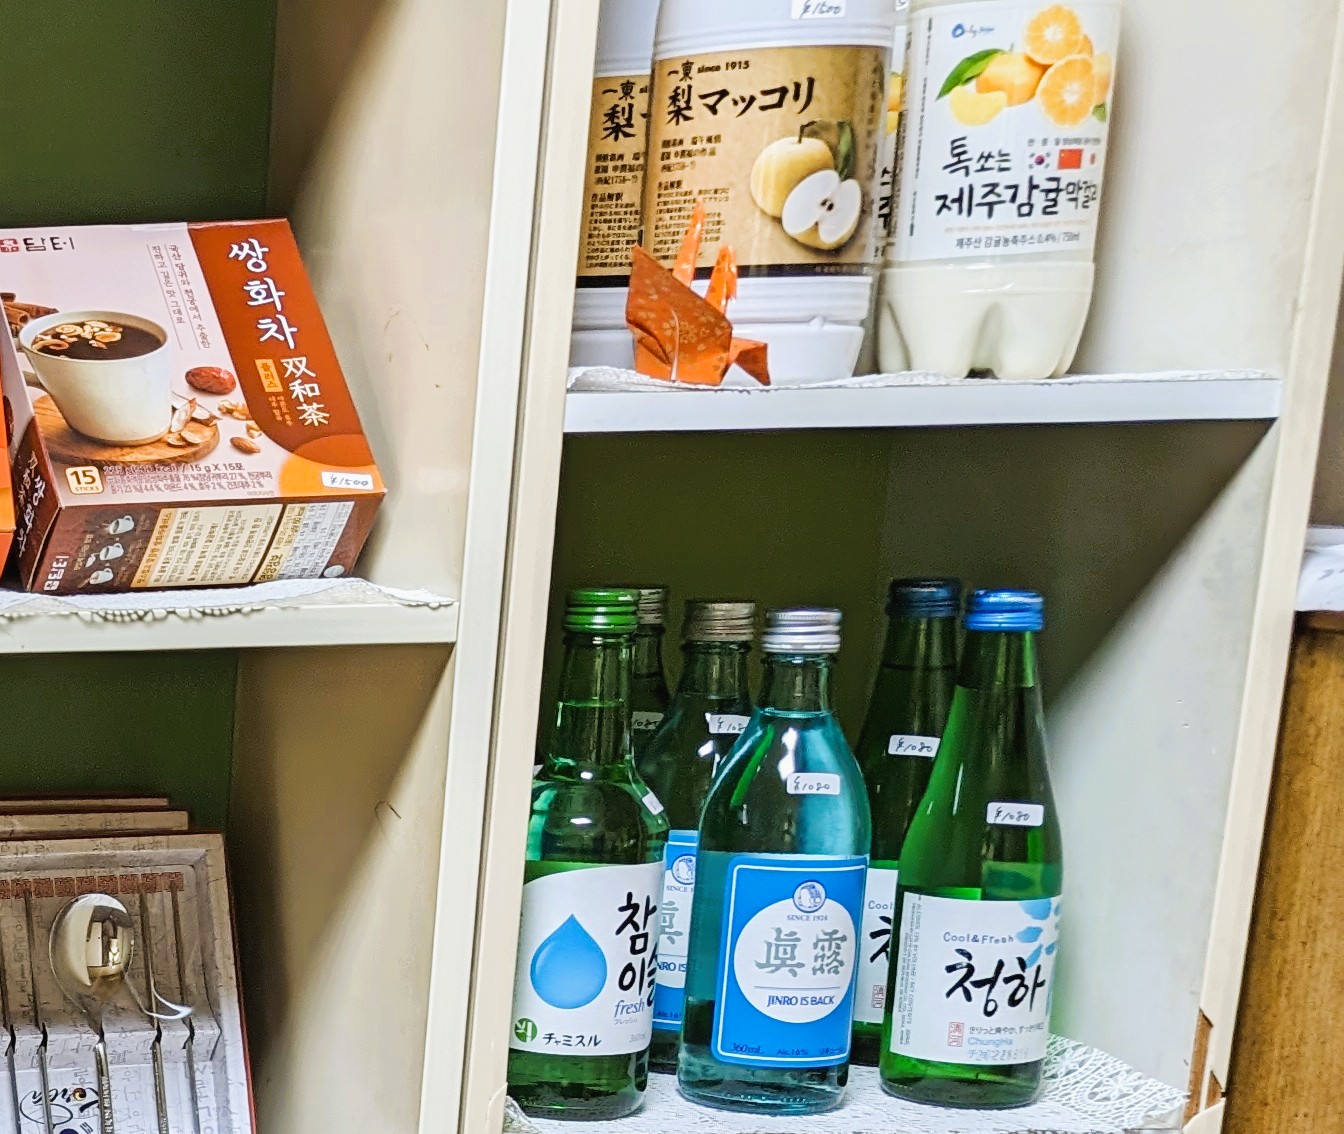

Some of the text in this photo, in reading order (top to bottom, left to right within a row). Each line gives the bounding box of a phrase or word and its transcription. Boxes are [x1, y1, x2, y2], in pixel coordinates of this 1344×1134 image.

[667, 77, 816, 126] 梨マッコリ
[228, 238, 298, 350] 쌍화차
[280, 356, 331, 427] 双和茶
[70, 469, 96, 486] 15
[786, 914, 811, 922] SINCE
[943, 931, 1014, 945] Cool&Fresh
[754, 926, 848, 978] 眞露
[944, 948, 1047, 1018] 청하
[614, 999, 645, 1018] fresh
[767, 995, 836, 1007] JINRO BACK
[542, 1032, 602, 1048] チャミスル
